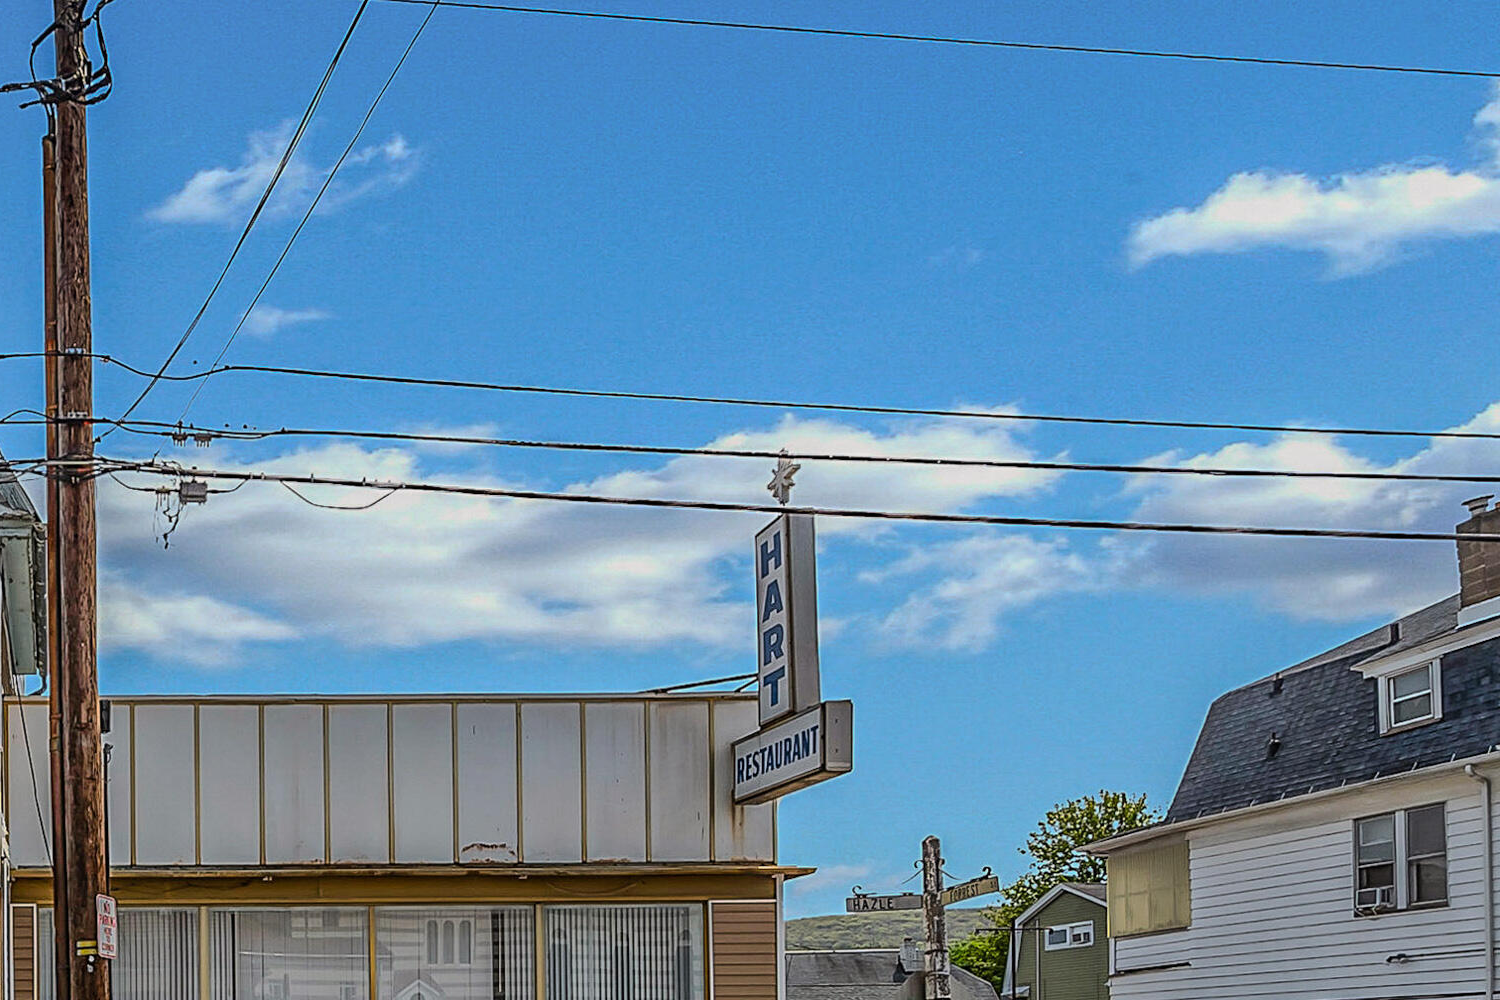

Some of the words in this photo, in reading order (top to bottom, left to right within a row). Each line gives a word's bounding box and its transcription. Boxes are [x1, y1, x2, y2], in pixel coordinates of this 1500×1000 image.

[760, 530, 786, 707] HART
[737, 725, 819, 784] RESTAURANT
[853, 898, 894, 911] HAZLE
